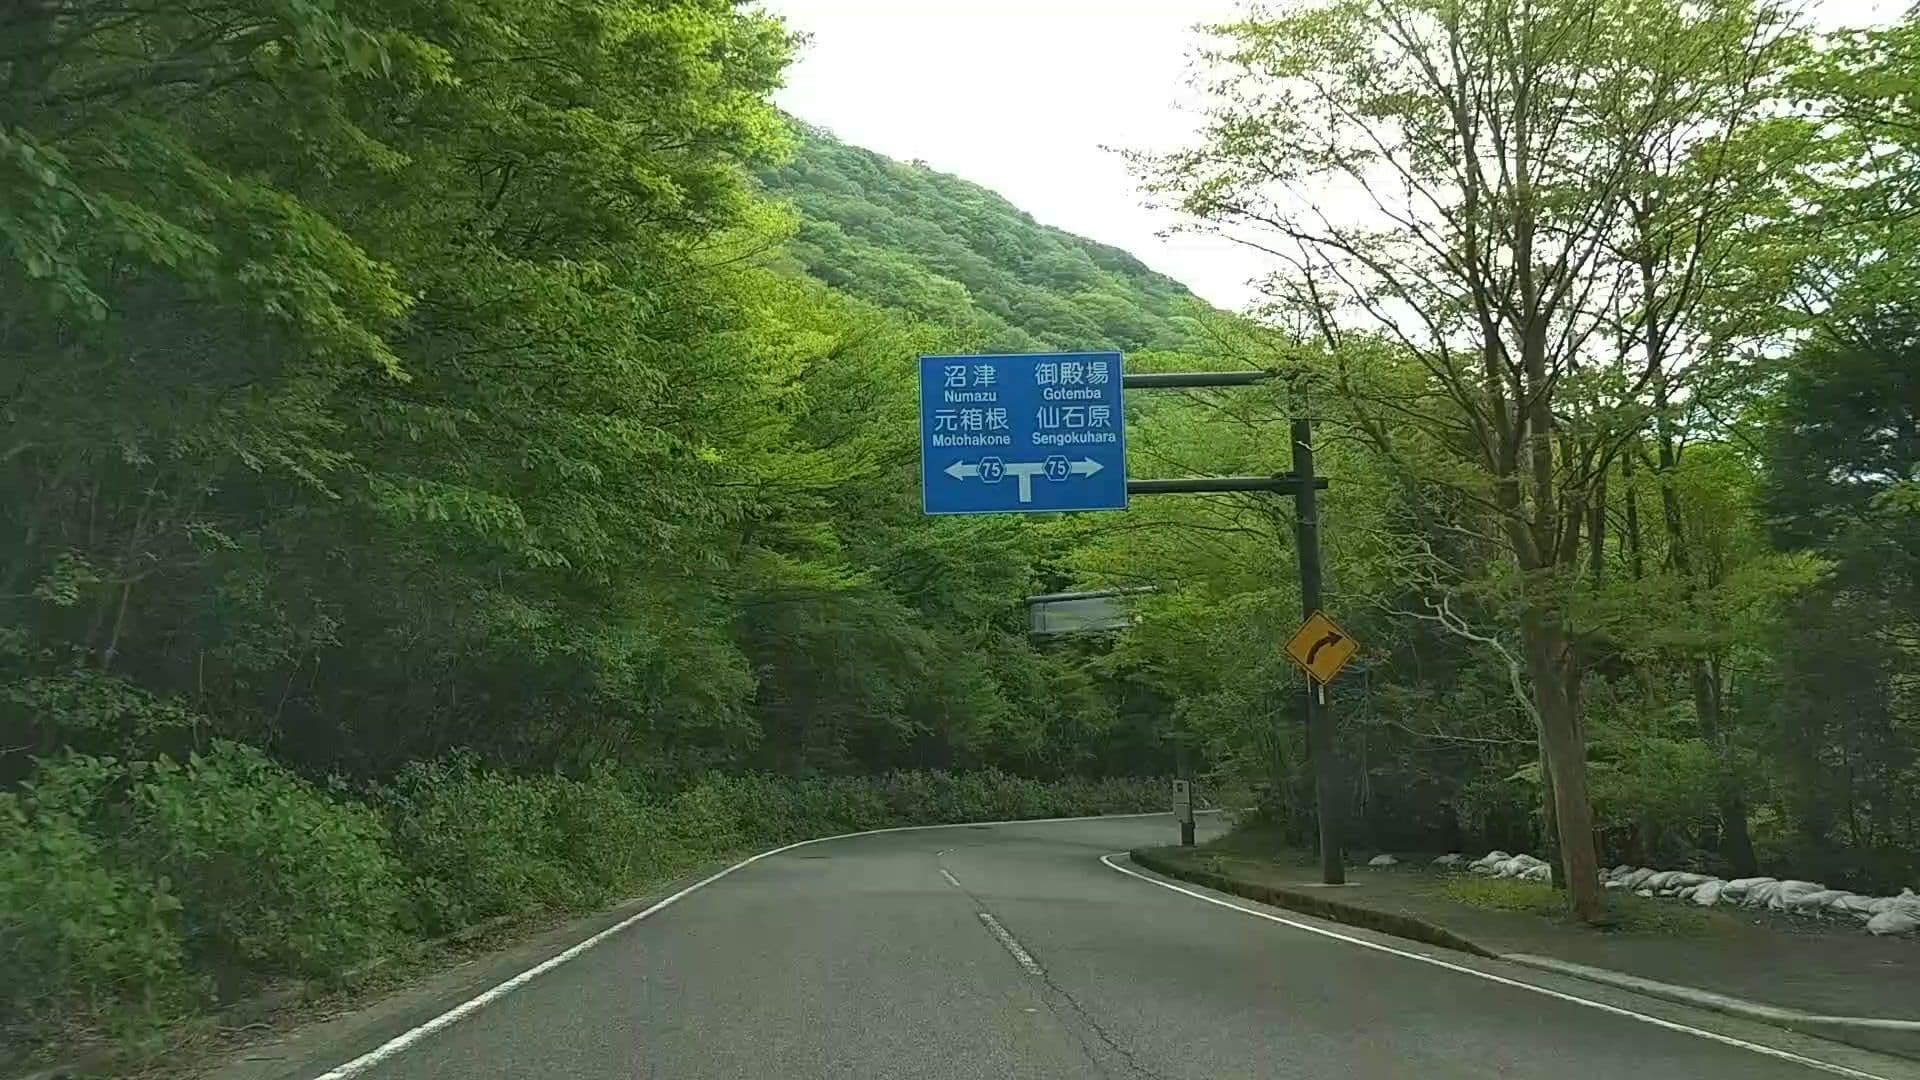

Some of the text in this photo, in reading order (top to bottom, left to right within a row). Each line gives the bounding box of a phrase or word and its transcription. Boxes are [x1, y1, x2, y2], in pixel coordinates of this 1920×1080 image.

[944, 363, 996, 387] 沼津
[1035, 362, 1109, 385] 御殿場
[945, 391, 996, 402] Numazu
[1044, 388, 1101, 400] Gotemba
[935, 407, 1009, 431] 元箱根
[1036, 405, 1111, 429] 仙石原
[933, 433, 1011, 446] Motohakone
[1032, 431, 1116, 446] Sengokuhara
[983, 462, 1000, 477] 75
[1049, 461, 1066, 475] 75
